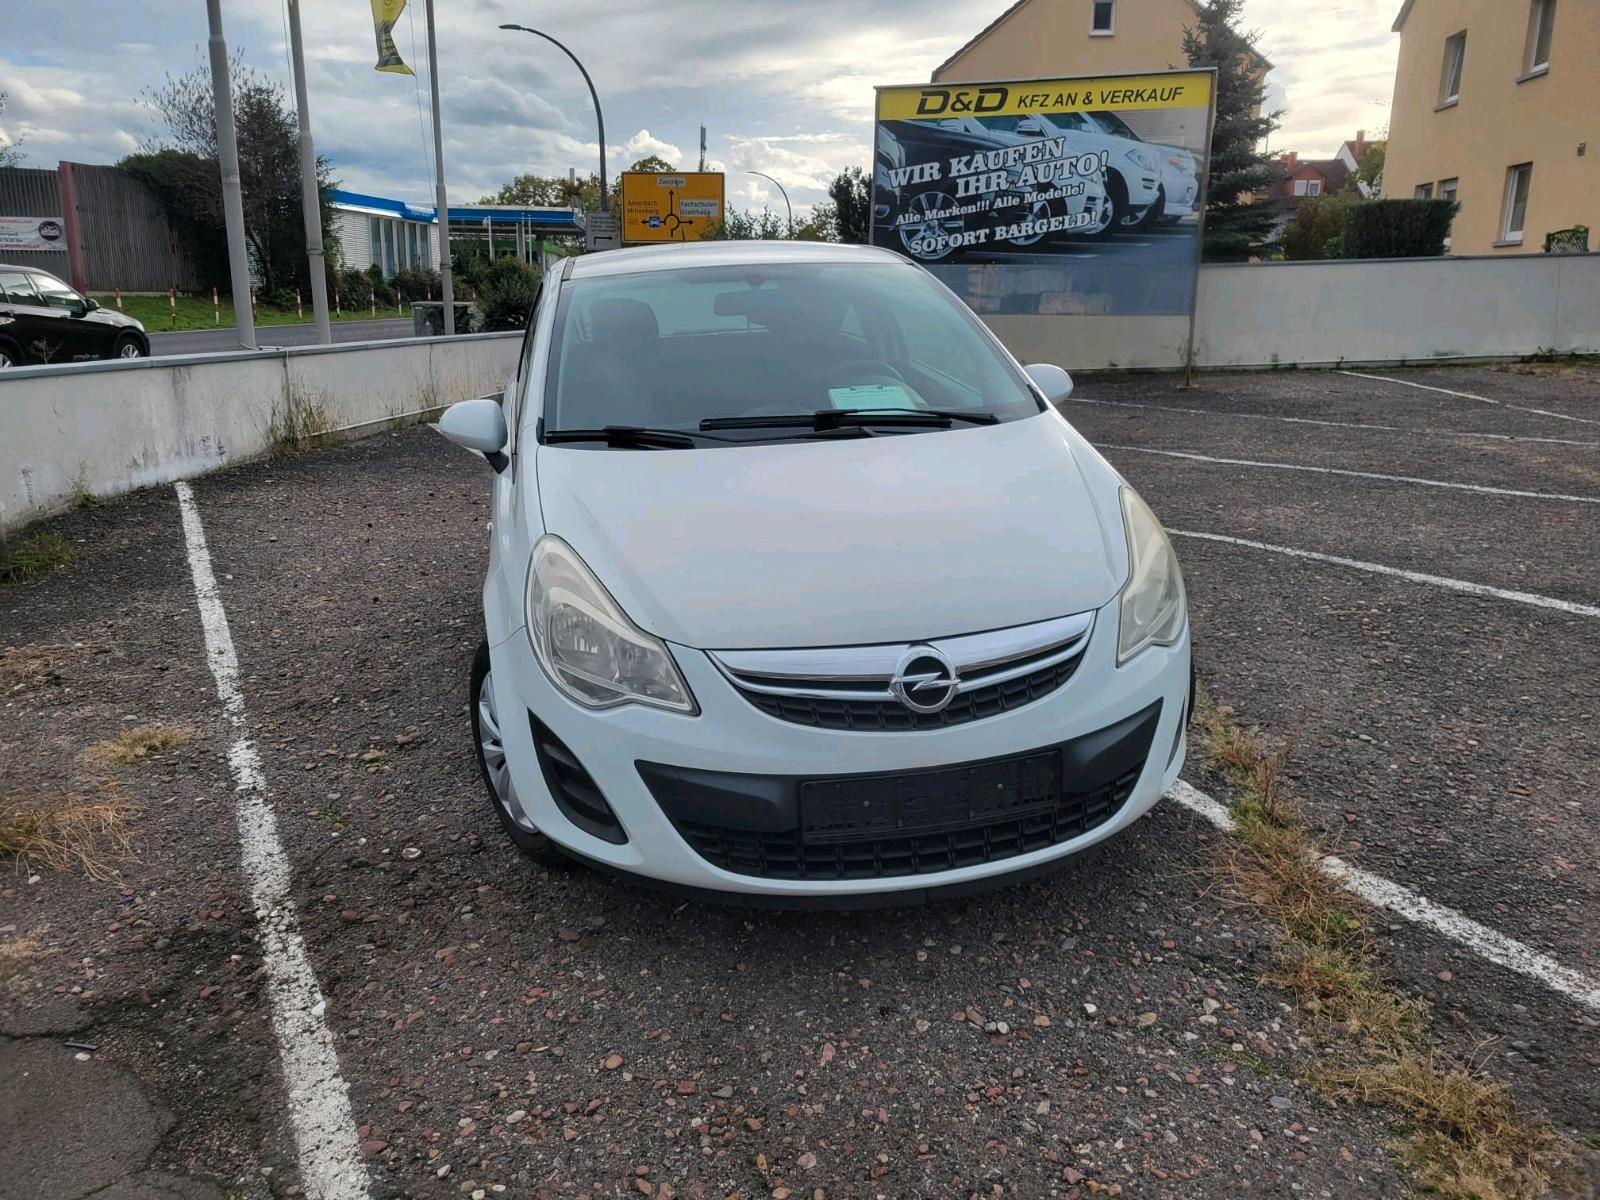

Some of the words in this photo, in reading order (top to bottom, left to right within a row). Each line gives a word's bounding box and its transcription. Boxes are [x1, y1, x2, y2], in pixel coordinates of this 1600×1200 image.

[916, 87, 1009, 115] D&D
[1017, 94, 1050, 109] KFZ
[1053, 92, 1077, 106] AN
[1082, 92, 1094, 105] &
[1100, 86, 1185, 105] VERKAUF
[888, 162, 942, 188] WIR
[948, 136, 1067, 178] KAUFEN
[955, 170, 1010, 199] IHR
[1015, 149, 1109, 188] AUTO!
[895, 212, 921, 226] Alle
[924, 199, 990, 221] Marken!!!
[993, 194, 1020, 210] Alle
[1023, 182, 1085, 204] Modelle!
[910, 228, 990, 254] SOFORT
[994, 211, 1098, 241] BARGELD!
